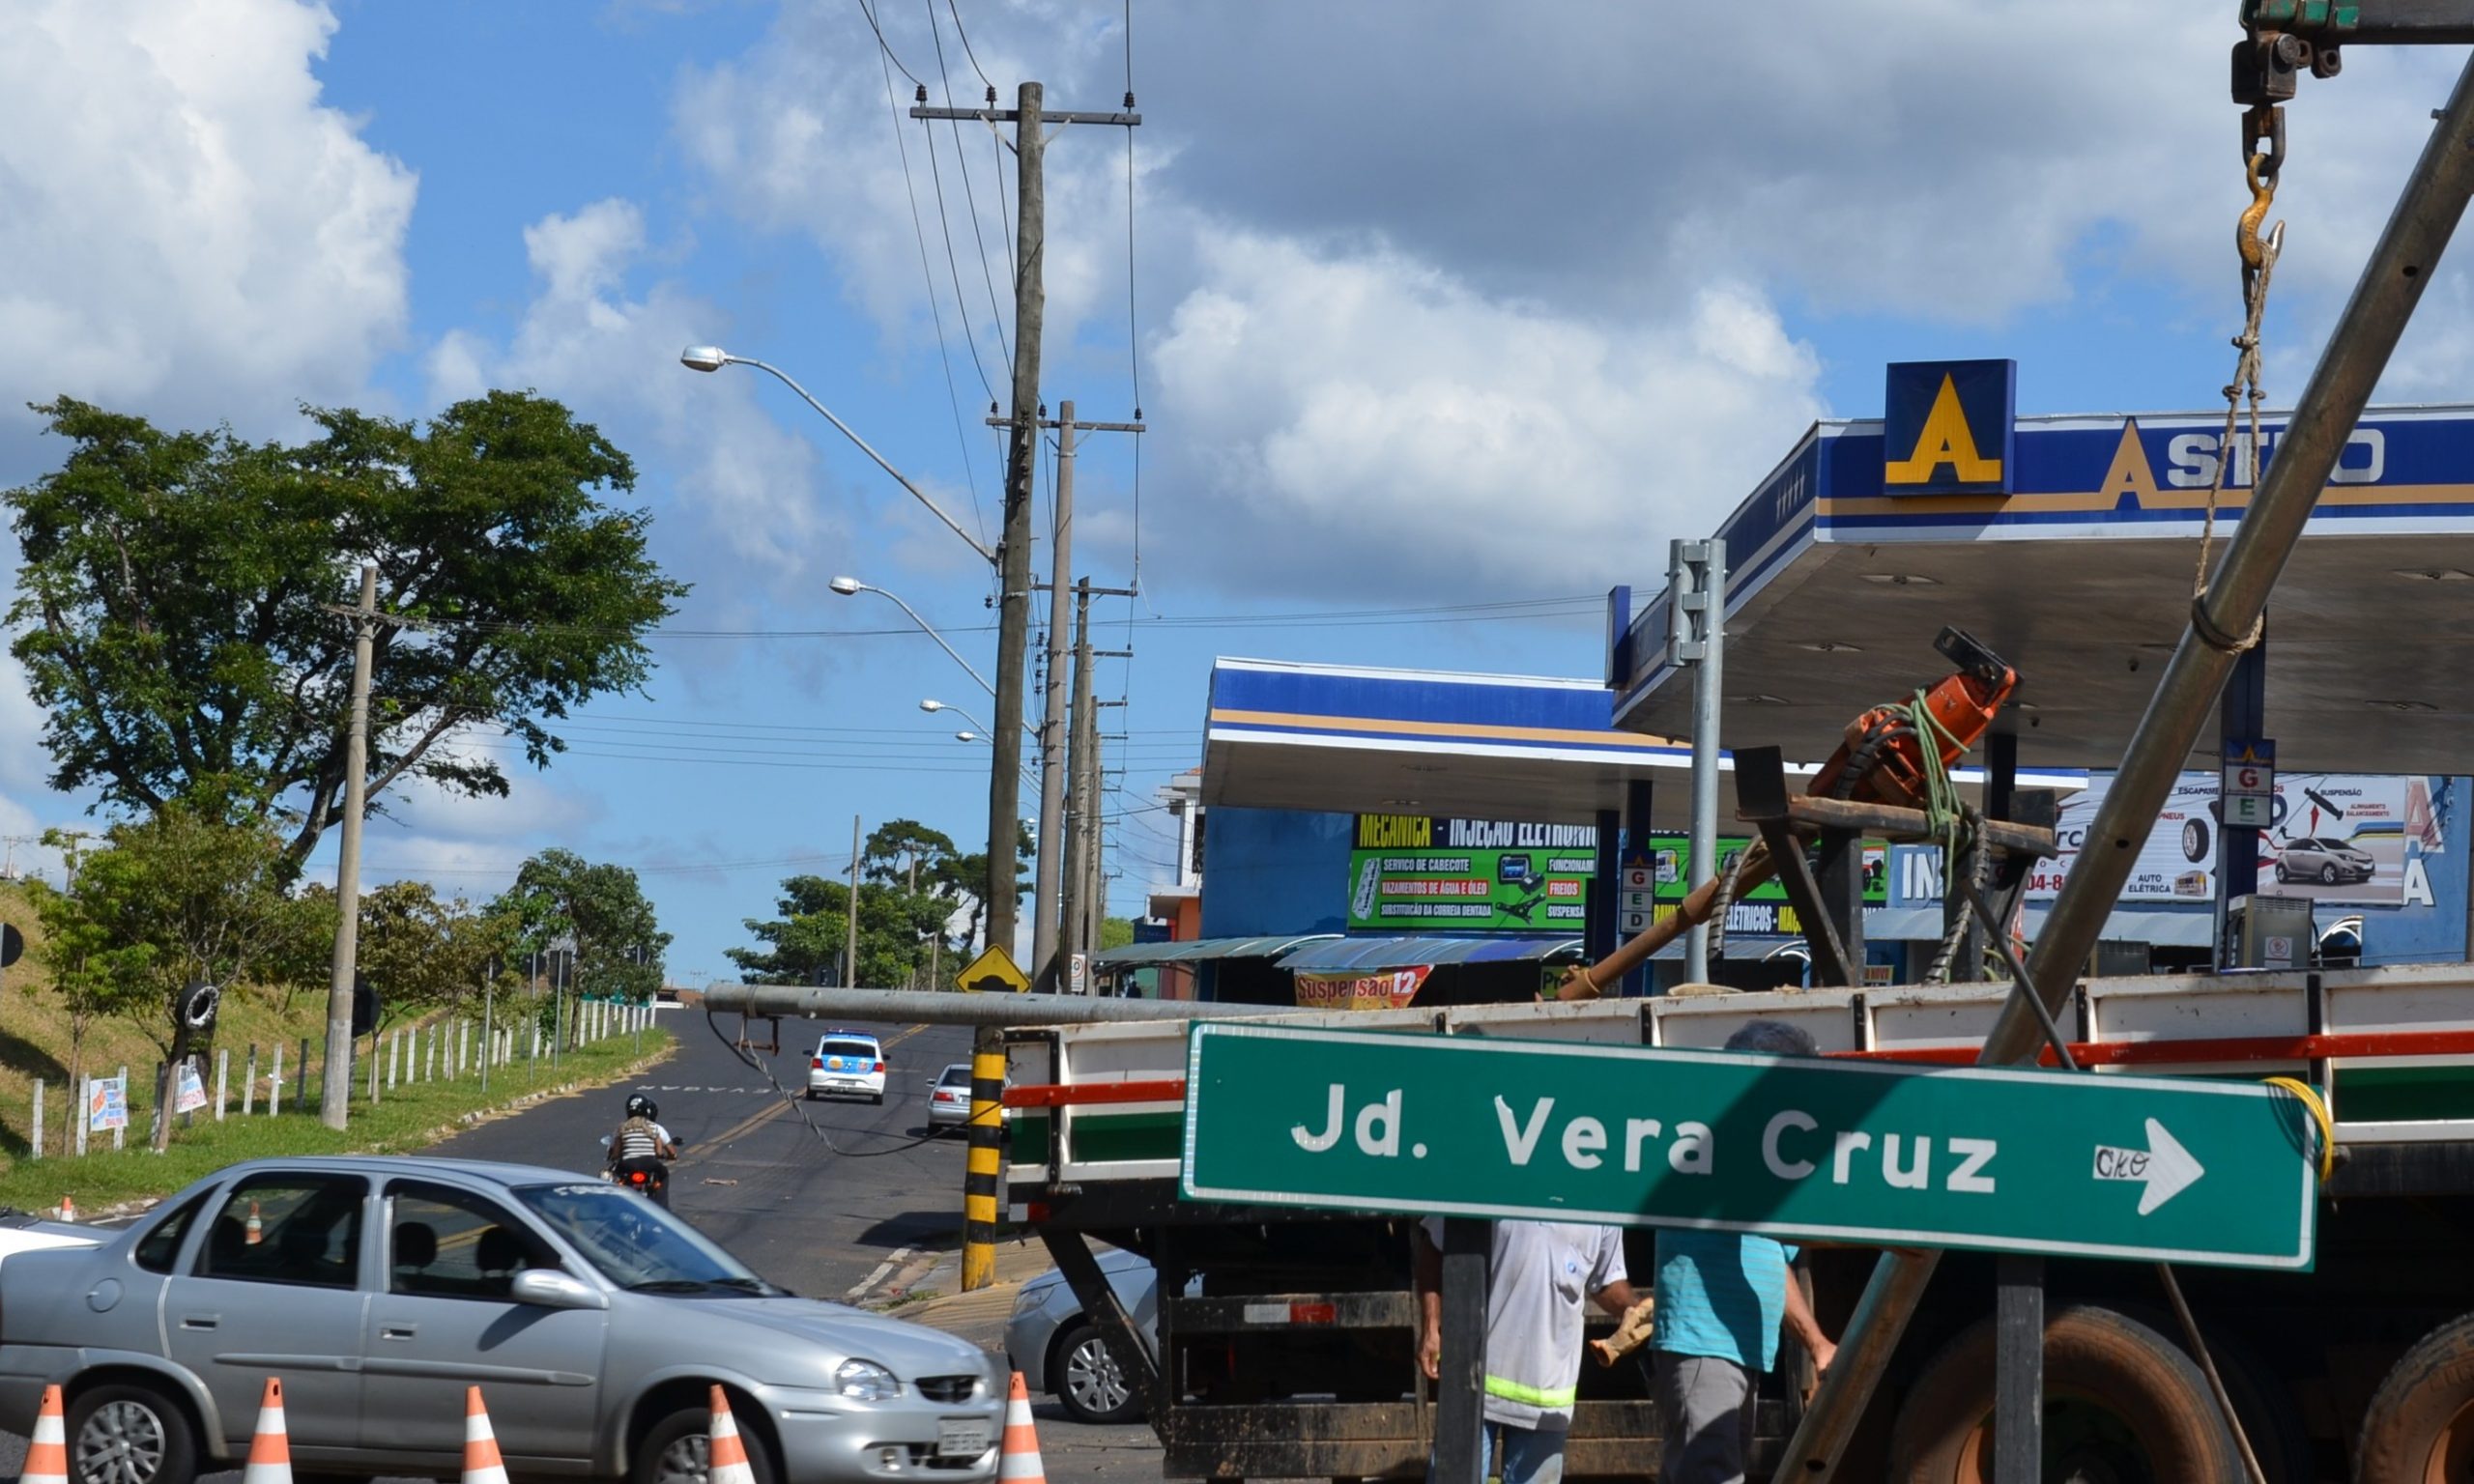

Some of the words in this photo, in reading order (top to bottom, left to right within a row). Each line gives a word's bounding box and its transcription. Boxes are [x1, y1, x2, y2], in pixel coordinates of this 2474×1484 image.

[2099, 415, 2384, 510] ASTO
[2239, 769, 2258, 787] G
[2240, 799, 2255, 815] E
[1416, 858, 1427, 871] DE
[1631, 871, 1645, 885] G
[1382, 881, 1427, 895] VAZAMENTOS
[1428, 882, 1439, 895] DE
[1440, 879, 1460, 895] ÁGUA
[1461, 882, 1467, 895] E
[1468, 879, 1487, 896] ÓLEO
[1549, 882, 1578, 896] FREIOS
[2128, 883, 2171, 894] ELÉTRICA
[1632, 894, 1643, 905] E
[1424, 904, 1432, 916] DA
[1631, 914, 1643, 927] D
[1298, 976, 1389, 1002] Suspensão
[1393, 971, 1416, 994] 12
[1291, 1083, 1428, 1159] Jd.
[1494, 1094, 1712, 1174] Vera
[1764, 1111, 1998, 1194] Cruz
